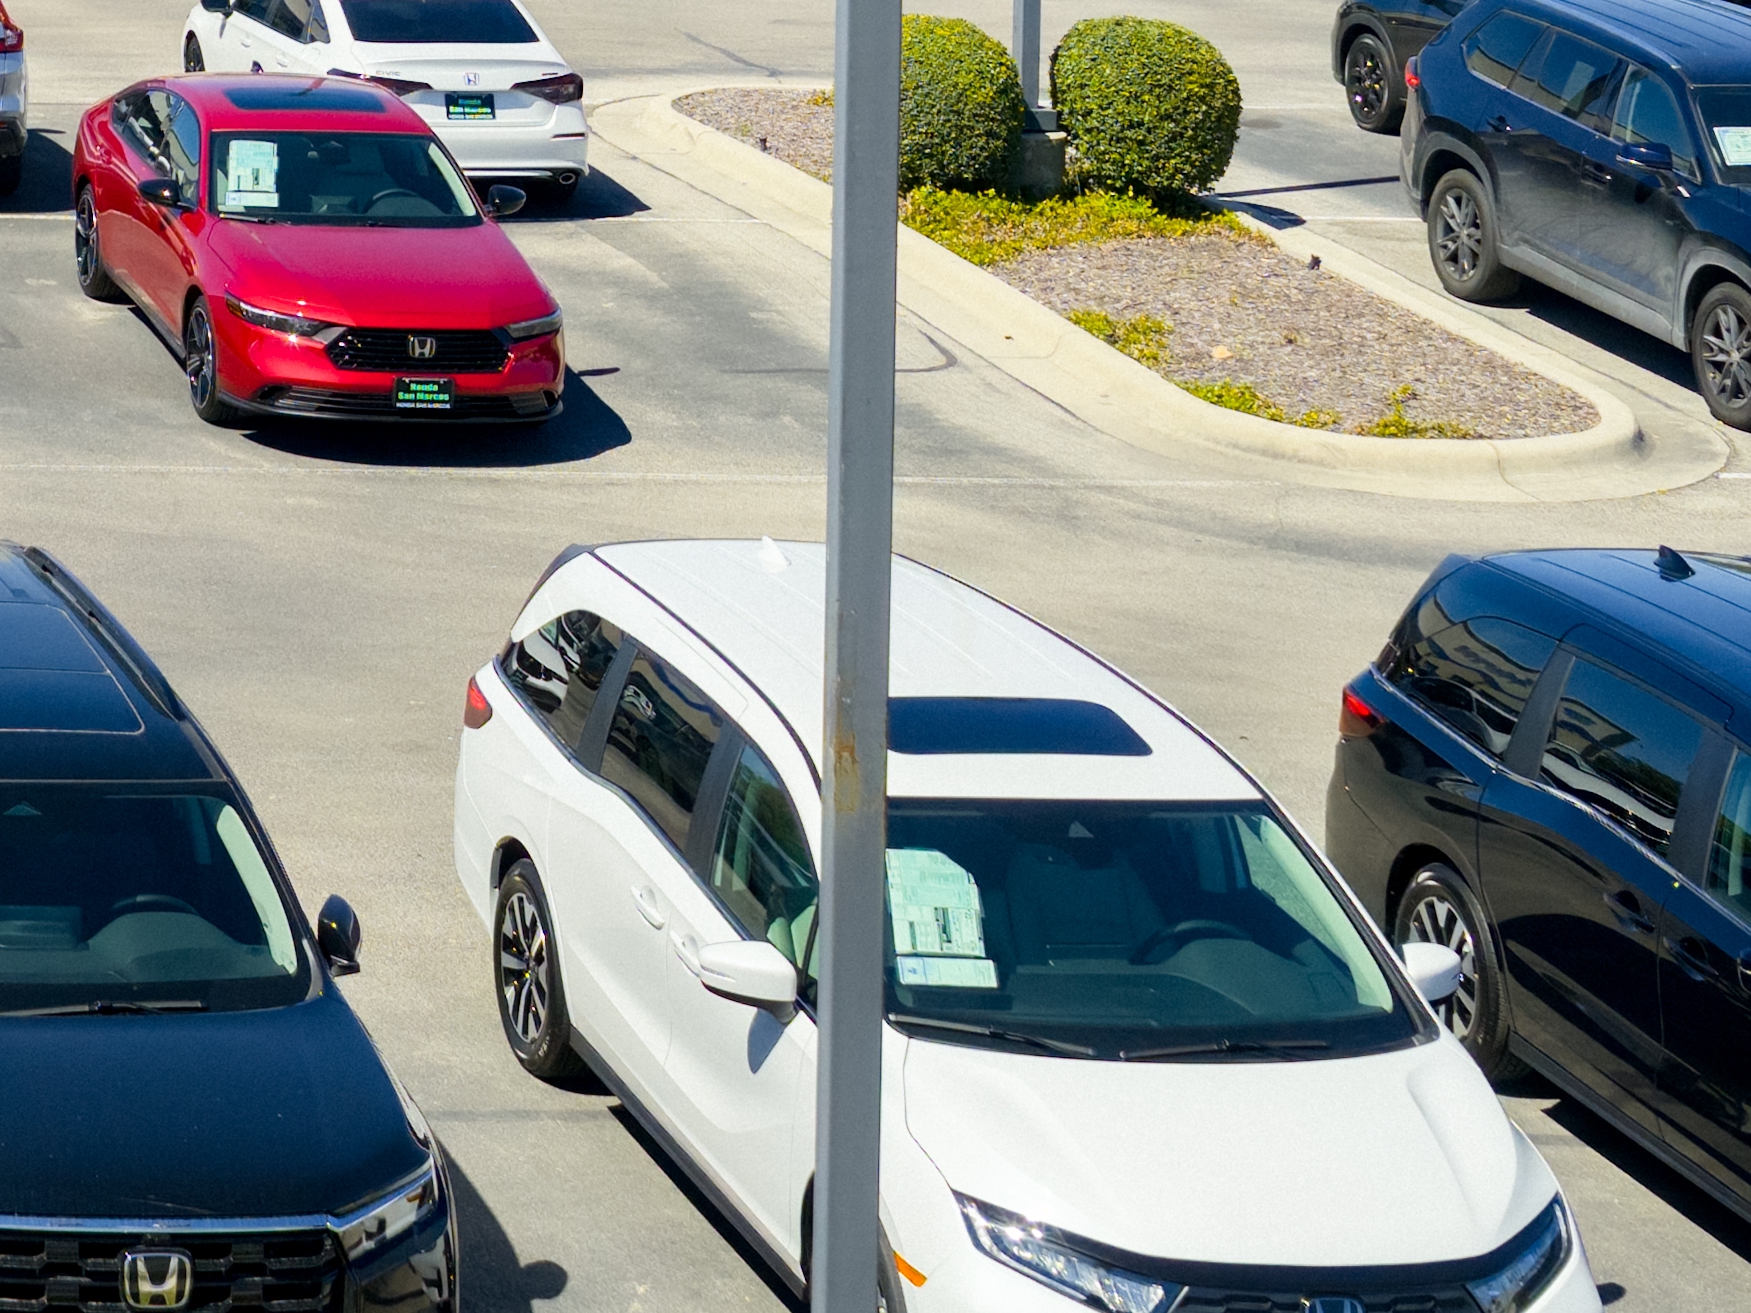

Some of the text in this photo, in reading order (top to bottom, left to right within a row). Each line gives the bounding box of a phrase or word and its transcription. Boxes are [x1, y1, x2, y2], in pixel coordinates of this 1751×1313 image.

[410, 383, 438, 391] Honda
[398, 392, 450, 401] San Marcos
